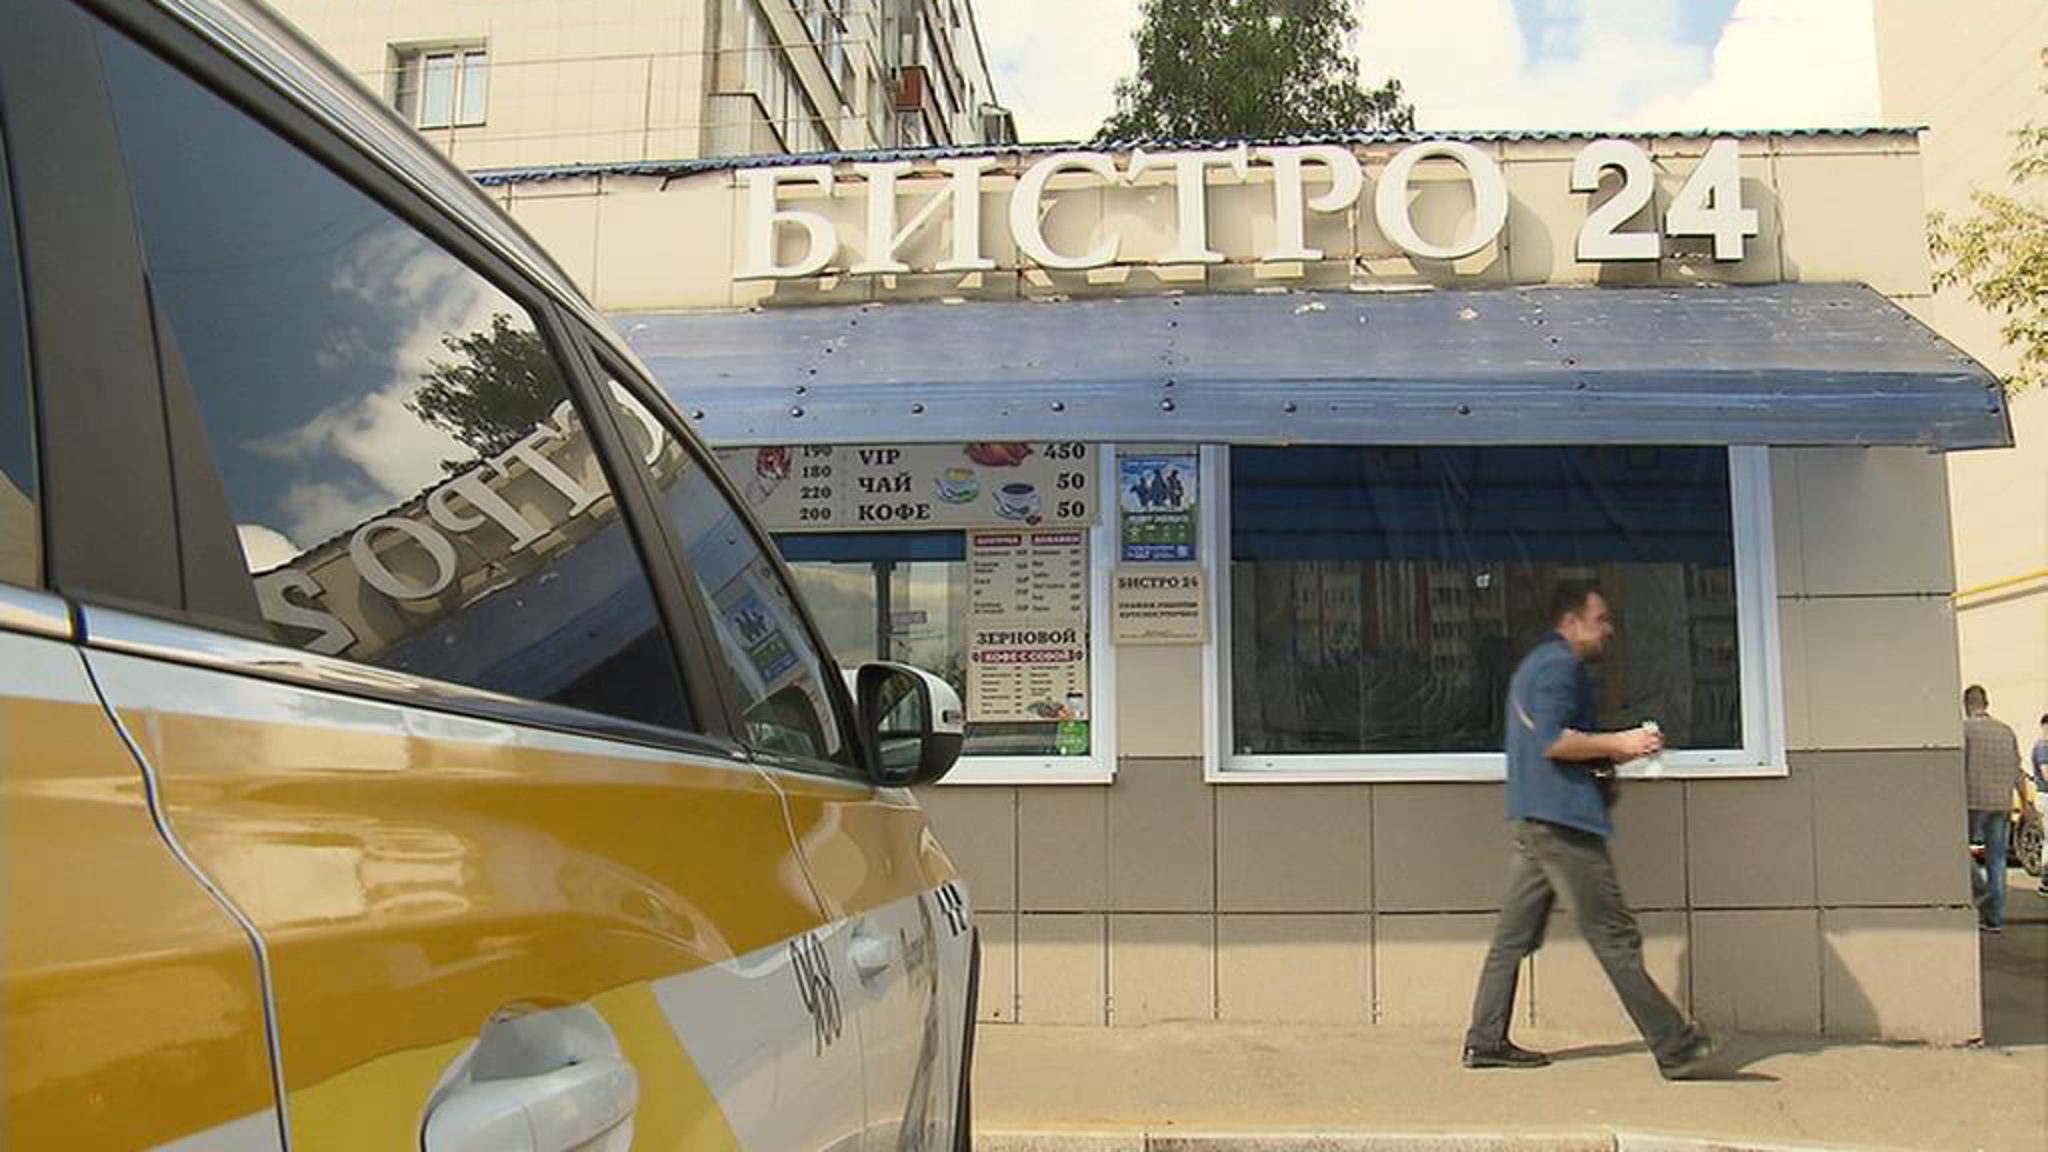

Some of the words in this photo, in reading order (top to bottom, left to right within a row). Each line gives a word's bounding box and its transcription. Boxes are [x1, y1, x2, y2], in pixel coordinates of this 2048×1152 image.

[732, 138, 1511, 282] БИСТРО
[1568, 137, 1760, 264] 24
[858, 449, 900, 466] VIP
[858, 471, 912, 492] ЧАЙ
[1057, 474, 1084, 490] 50
[800, 508, 831, 520] 200
[858, 503, 931, 521] КОФЕ
[1057, 502, 1084, 517] 50
[1119, 577, 1179, 588] БИСТРО
[977, 628, 1076, 644] ЗЕРНОВОЙ
